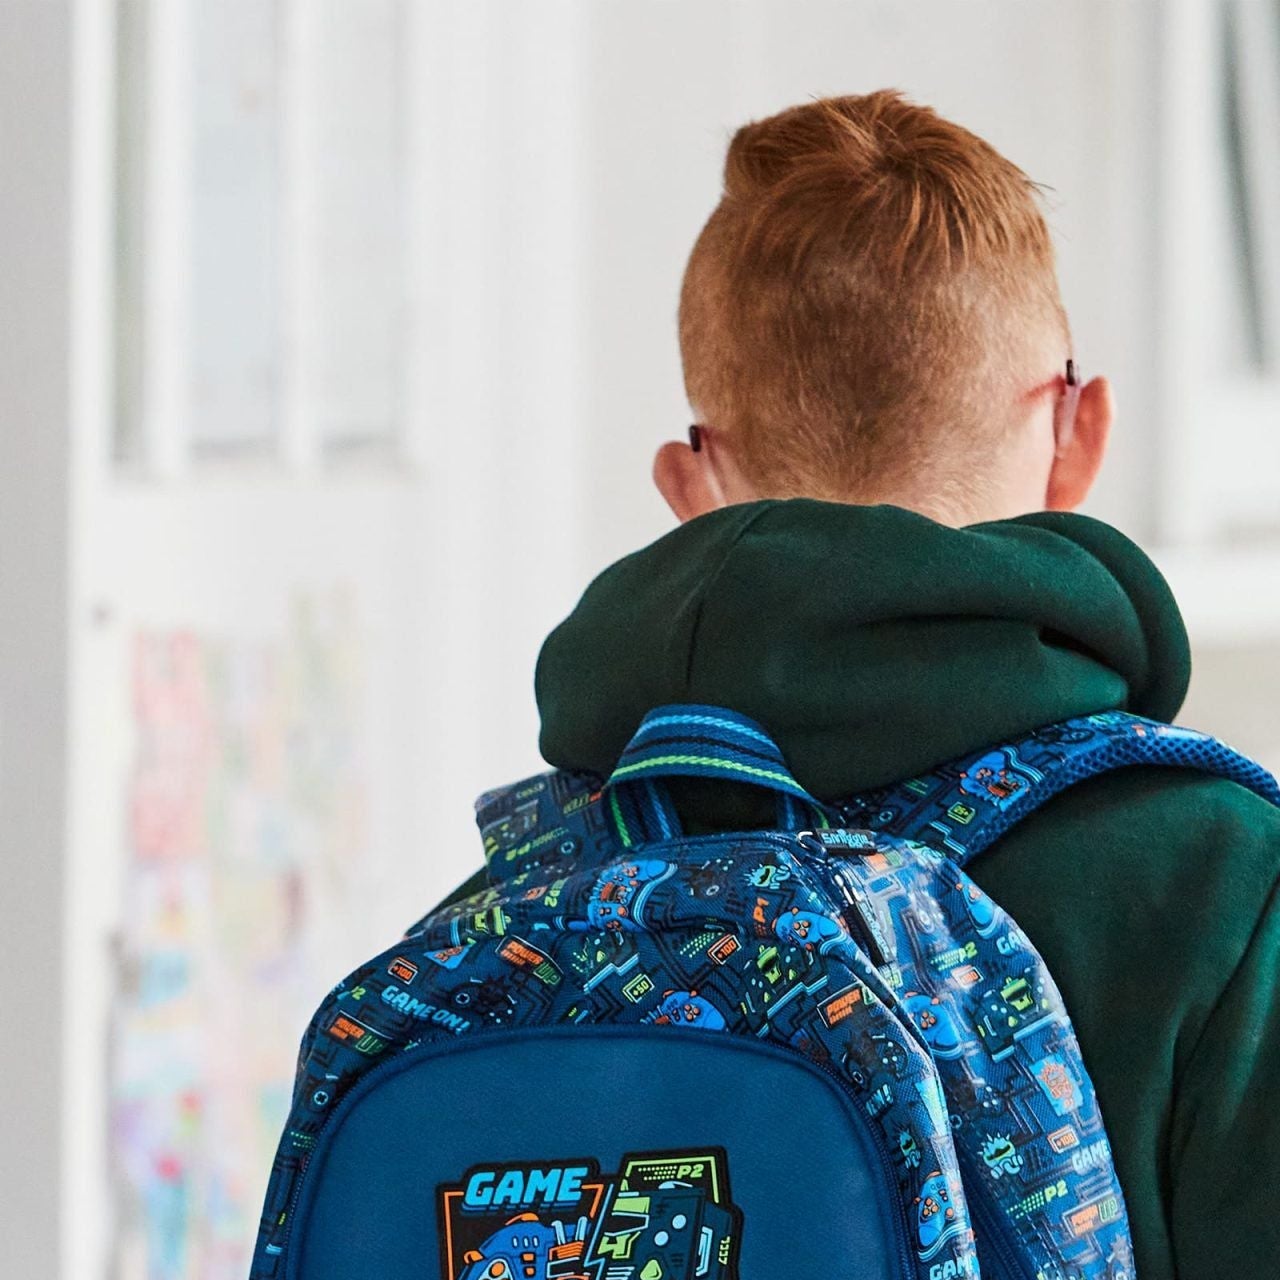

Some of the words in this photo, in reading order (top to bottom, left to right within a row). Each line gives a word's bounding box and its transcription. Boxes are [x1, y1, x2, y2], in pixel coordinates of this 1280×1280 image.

[381, 985, 431, 1019] GAME
[432, 1008, 471, 1036] ON!
[676, 1164, 705, 1179] P2
[463, 1167, 588, 1211] GAME
[1044, 1180, 1068, 1202] P2
